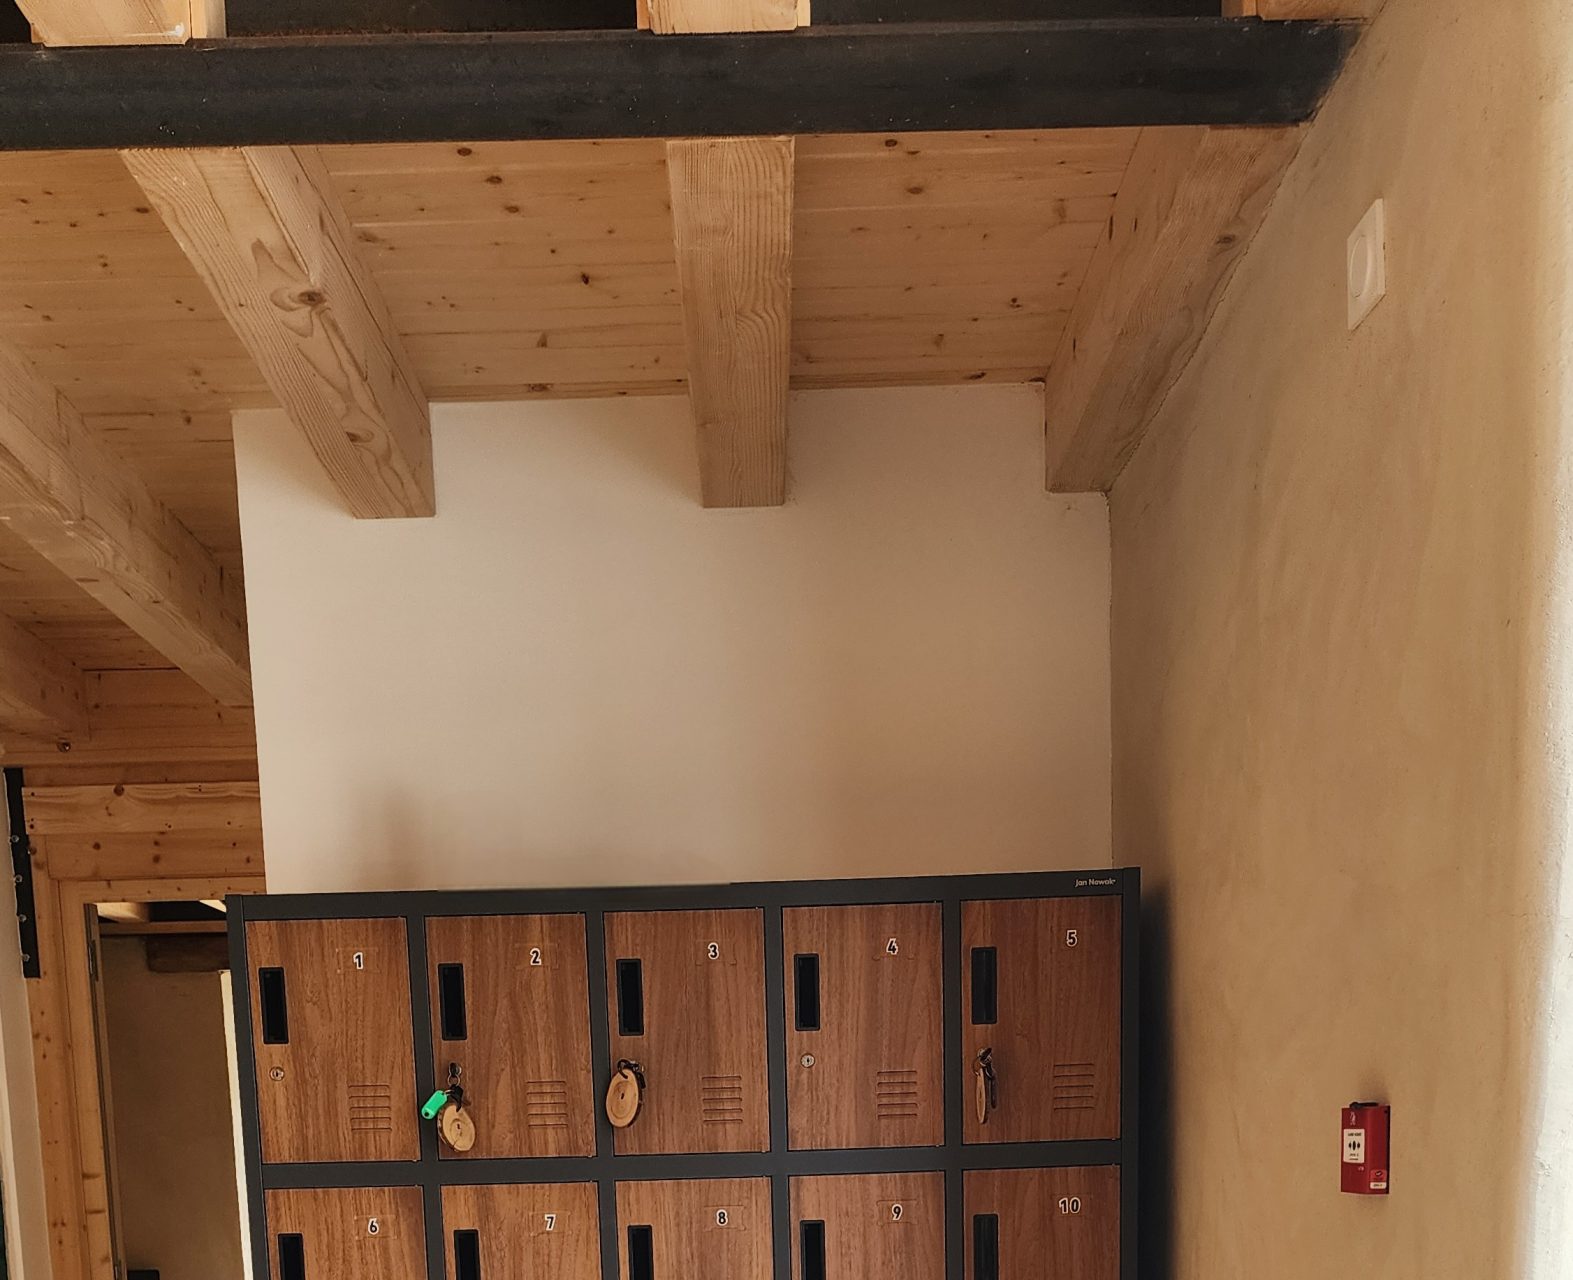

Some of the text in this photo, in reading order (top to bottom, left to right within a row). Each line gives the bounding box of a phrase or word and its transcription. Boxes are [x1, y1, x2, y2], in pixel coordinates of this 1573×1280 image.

[1074, 879, 1088, 888] Jan
[887, 938, 898, 954] 4
[1066, 930, 1077, 946] 5
[530, 948, 541, 965] 2
[708, 942, 719, 960] 3
[353, 952, 363, 969] 1
[892, 1204, 902, 1220] 9
[1059, 1197, 1081, 1213] 10
[545, 1214, 556, 1230] 7
[717, 1209, 727, 1225] 8
[368, 1218, 379, 1234] 6
